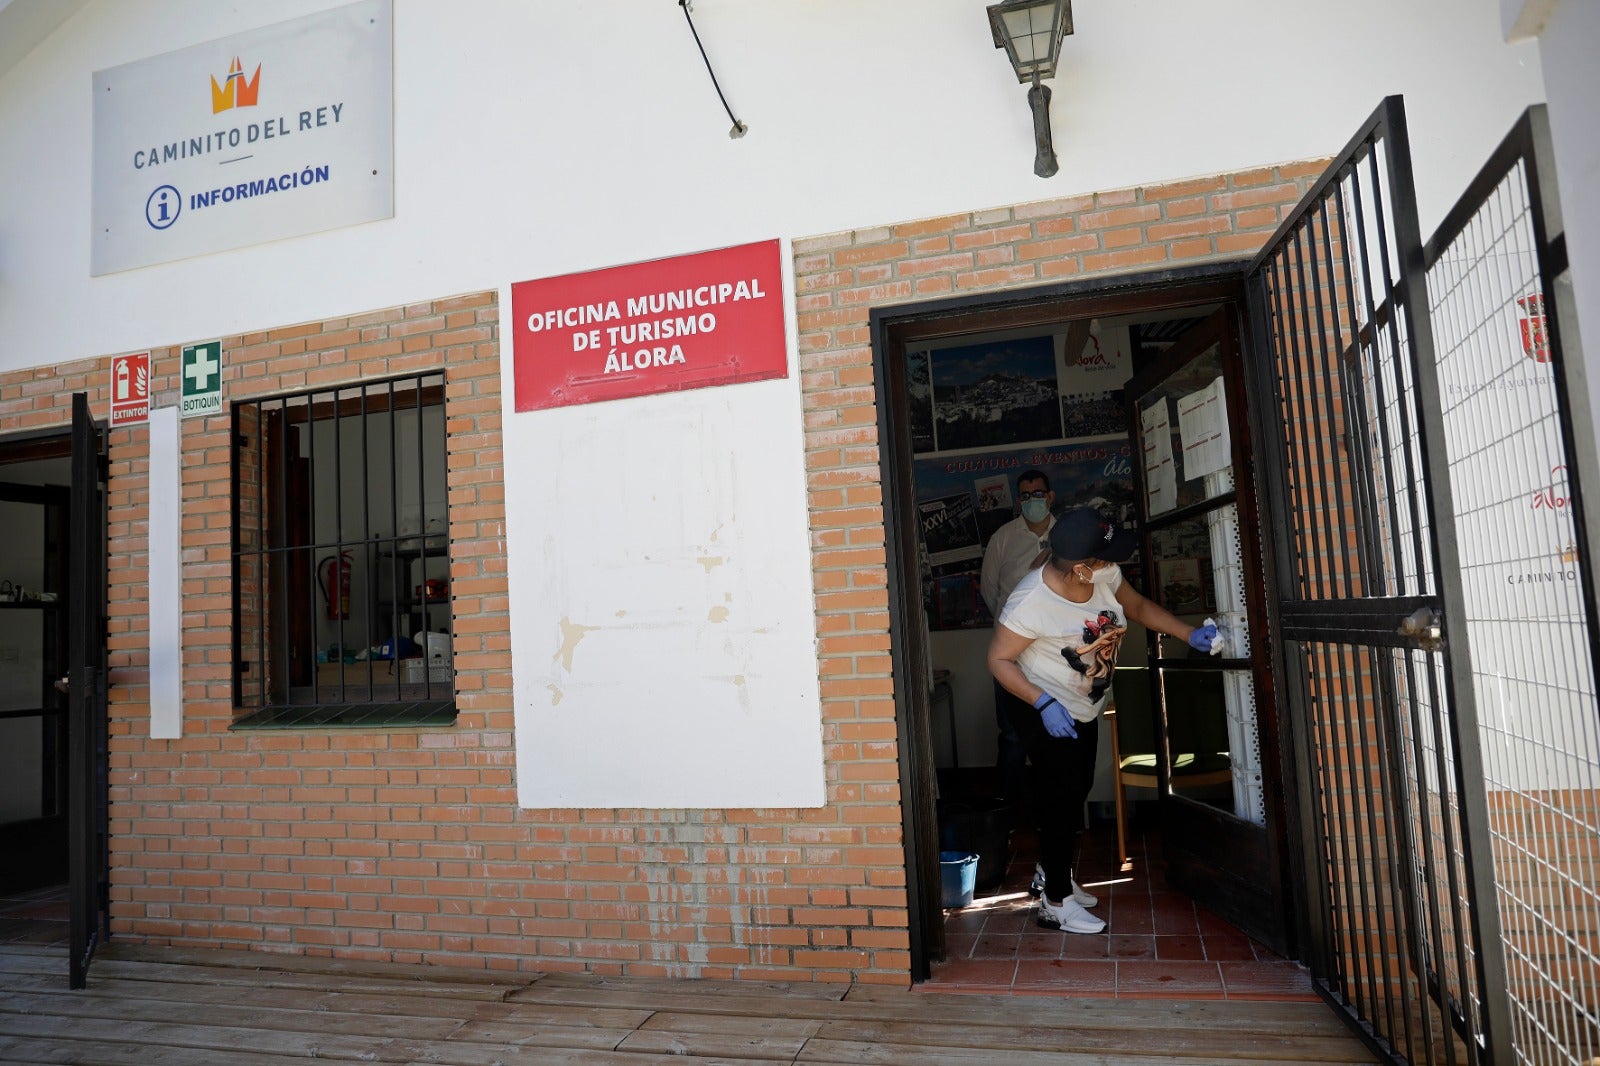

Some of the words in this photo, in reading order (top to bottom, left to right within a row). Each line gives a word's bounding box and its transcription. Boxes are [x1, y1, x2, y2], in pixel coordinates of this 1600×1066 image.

[134, 128, 241, 170] CAMINITO
[247, 117, 290, 143] DEL
[299, 102, 344, 131] REY
[190, 165, 330, 210] INFORMACIÓN
[527, 301, 620, 332] OFICINA
[627, 278, 766, 317] MUNICIPAL
[573, 332, 601, 352] DE
[606, 313, 716, 347] TURISMO
[603, 344, 686, 374] ÁLORA
[113, 406, 147, 420] EXTINTOR
[183, 393, 220, 411] BOTIQUÍN
[944, 456, 1020, 474] CULTURA
[1031, 447, 1107, 466] EVENTOS
[1103, 455, 1132, 477] Álo
[922, 509, 948, 533] XXVI
